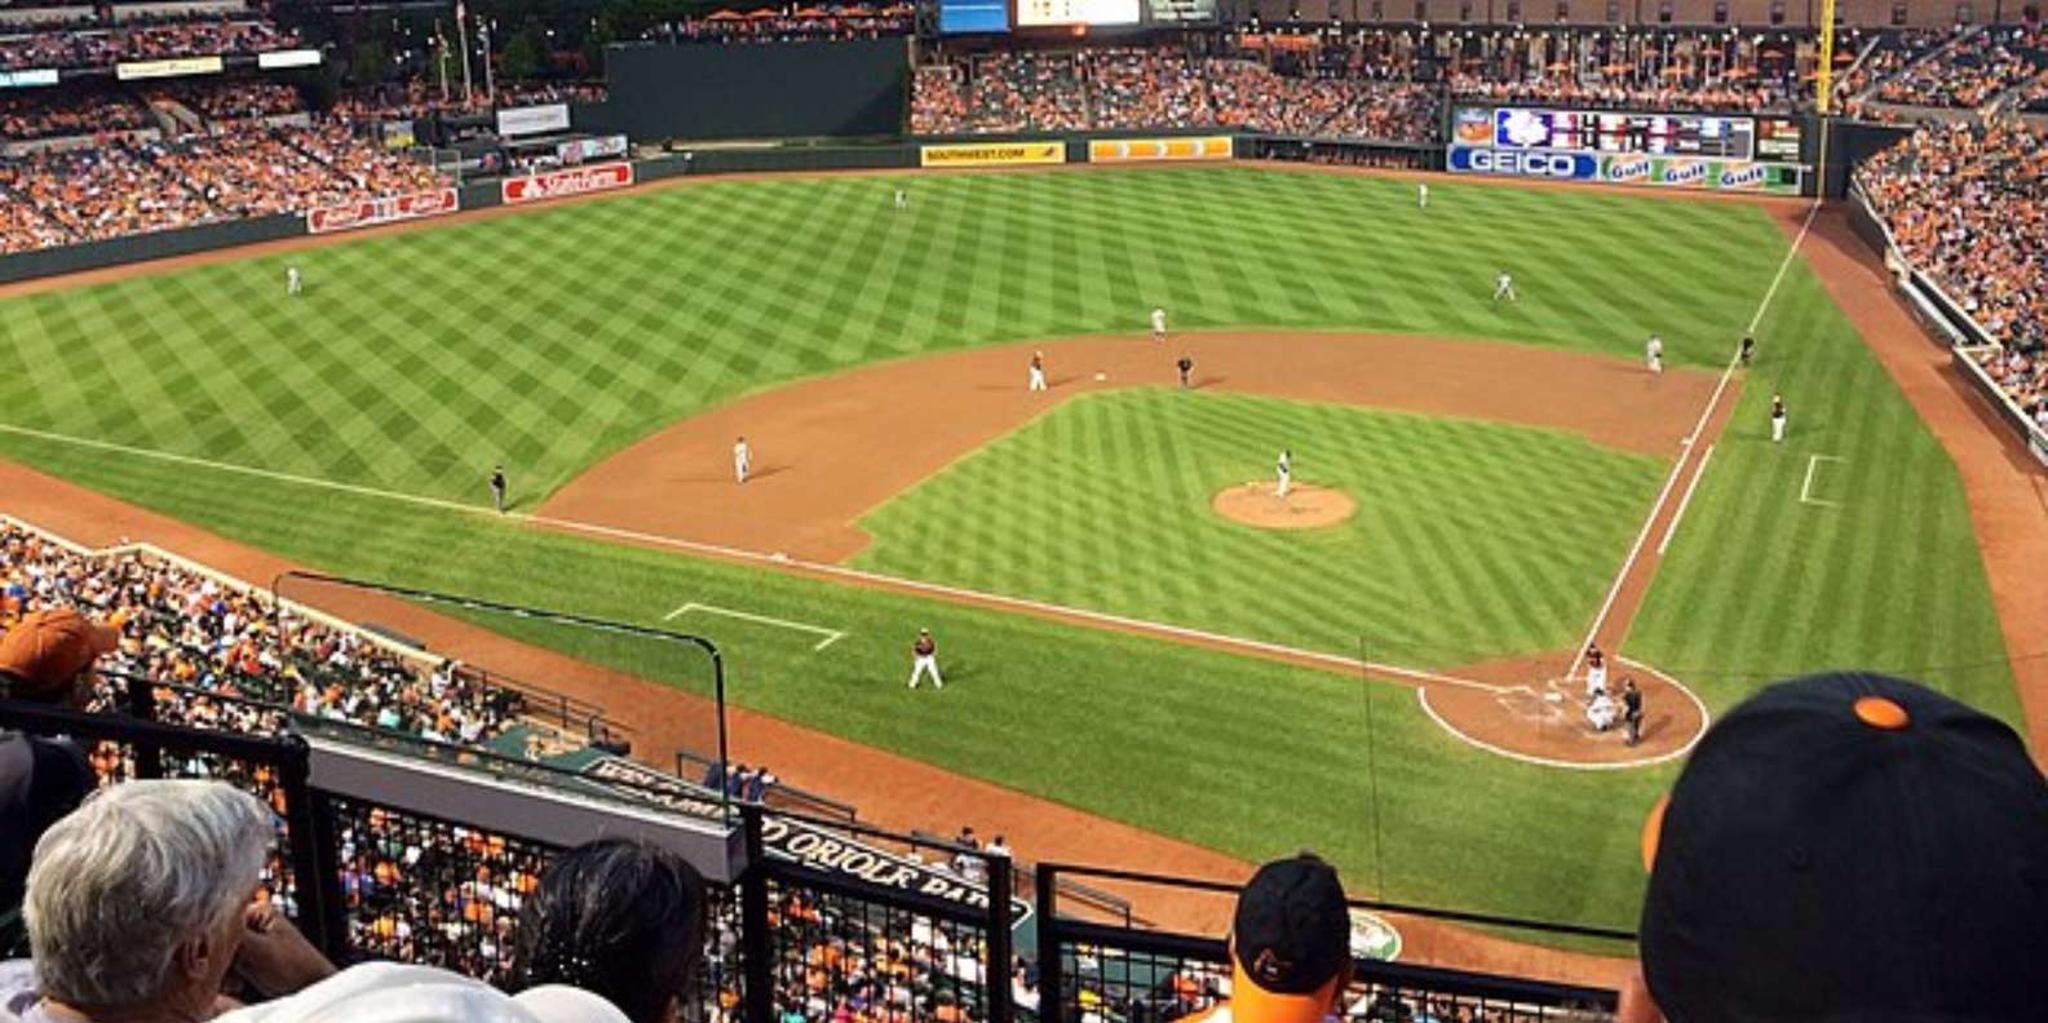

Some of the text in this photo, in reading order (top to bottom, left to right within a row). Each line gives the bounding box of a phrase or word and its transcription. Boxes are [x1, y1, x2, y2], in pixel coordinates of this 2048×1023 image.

[927, 148, 1025, 161] SOUTHWEST.COM
[1470, 150, 1576, 176] GEICO
[1612, 161, 1650, 178] Gulf
[1666, 164, 1704, 182] Gulf
[1721, 167, 1763, 186] Gulf
[787, 834, 920, 889] ORIOLE
